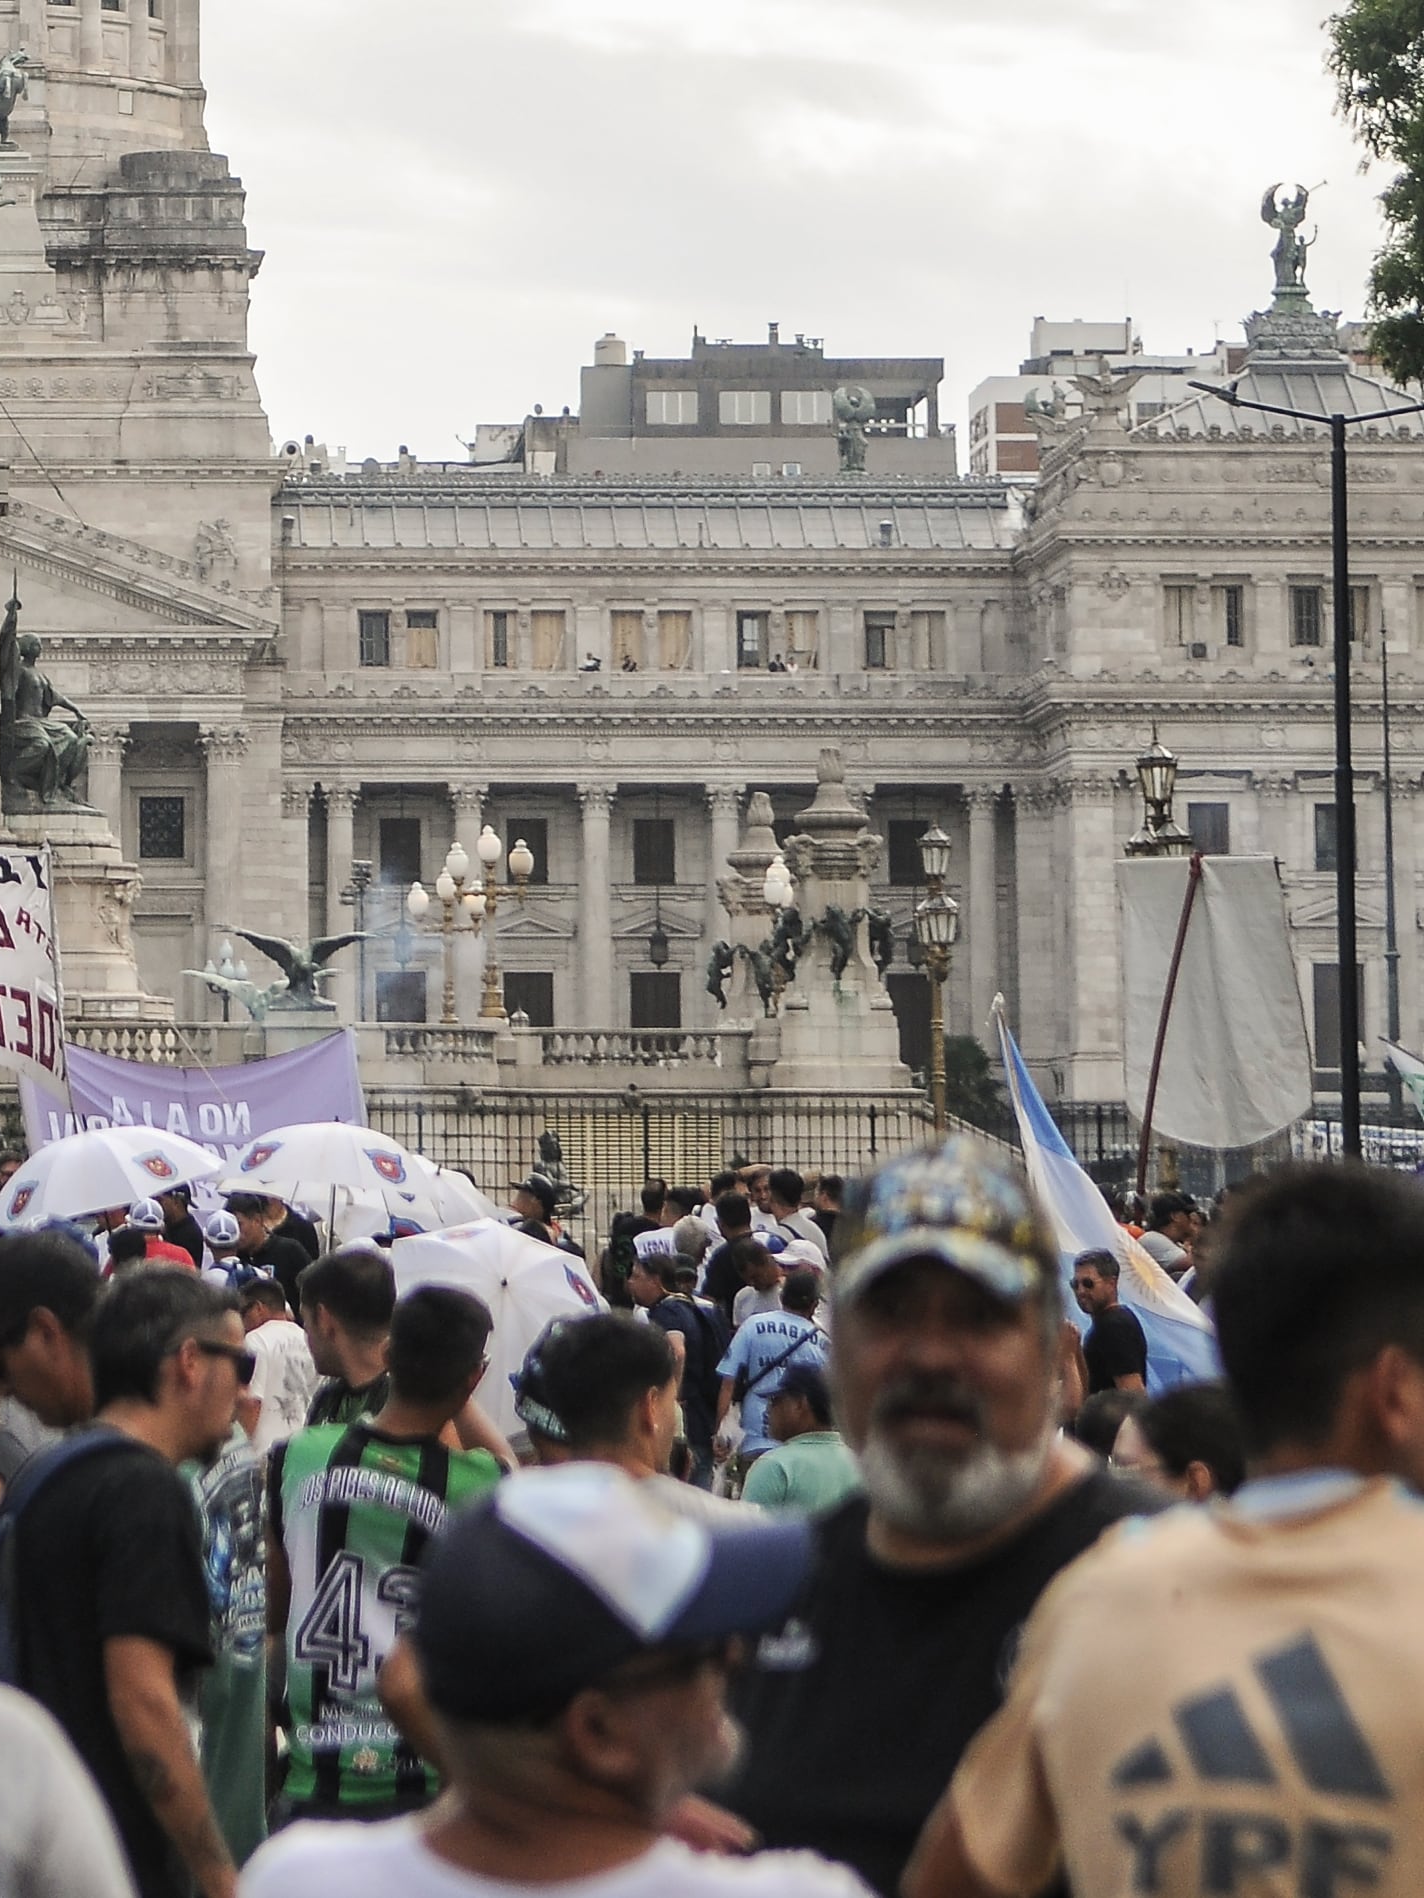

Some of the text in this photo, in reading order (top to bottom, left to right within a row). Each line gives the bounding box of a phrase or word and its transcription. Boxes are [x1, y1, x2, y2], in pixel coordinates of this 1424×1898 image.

[327, 1465, 381, 1500] PIBES
[407, 1482, 450, 1533] LUGA
[296, 1722, 401, 1743] CONDUCC
[1113, 1807, 1394, 1898] YPF
